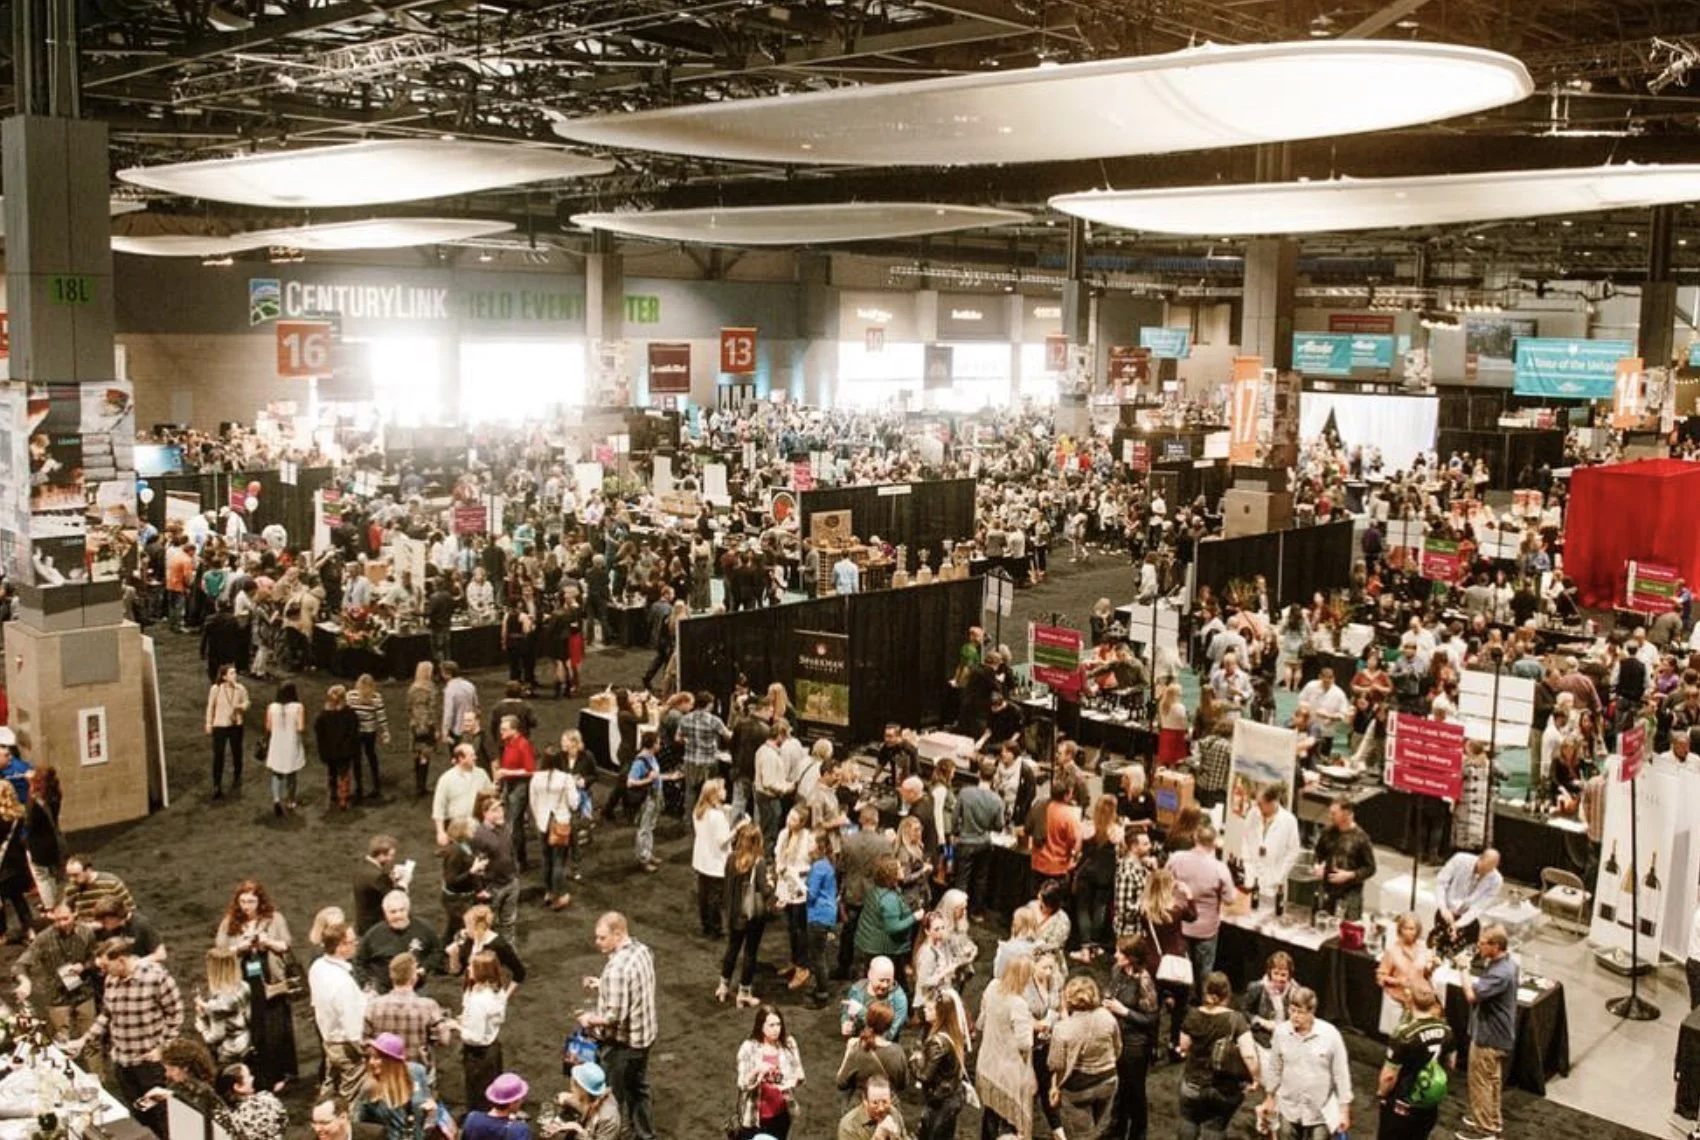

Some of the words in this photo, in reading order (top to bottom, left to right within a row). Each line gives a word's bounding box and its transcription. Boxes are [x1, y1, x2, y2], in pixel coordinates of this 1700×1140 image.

[54, 278, 89, 302] 18L
[627, 295, 660, 323] TER
[283, 333, 327, 369] 16
[724, 337, 752, 366] 13
[1617, 371, 1642, 416] 14
[1233, 379, 1259, 445] 17
